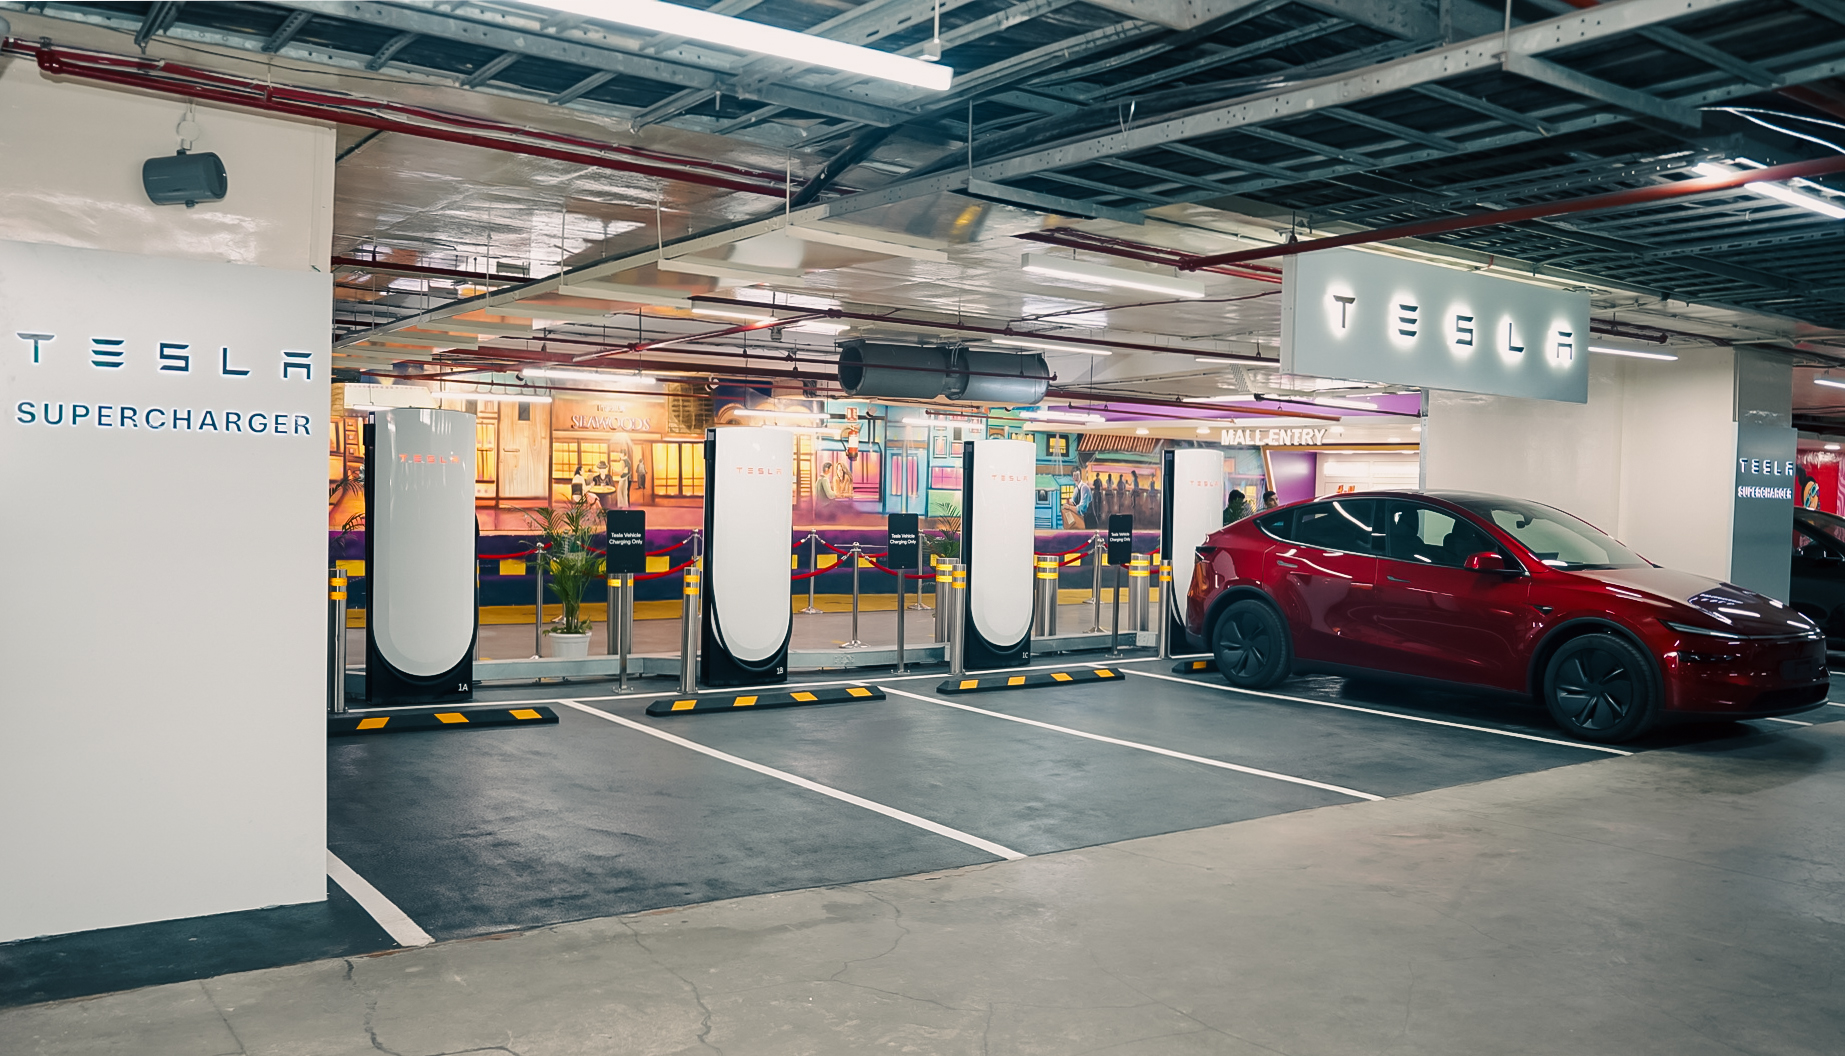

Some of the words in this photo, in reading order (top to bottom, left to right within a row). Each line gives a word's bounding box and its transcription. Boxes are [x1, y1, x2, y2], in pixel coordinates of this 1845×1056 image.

[1333, 294, 1574, 361] TESLA
[16, 332, 312, 380] TESLA
[16, 401, 311, 435] SUPERCHARGER
[571, 414, 651, 431] SEAWOODS
[1220, 429, 1268, 445] MALL
[1267, 429, 1327, 445] ENTRY
[399, 453, 459, 464] TESLA
[736, 466, 782, 475] TESLA
[991, 474, 1028, 482] TESLA
[1737, 485, 1793, 500] SUPERCHARGER
[458, 683, 468, 691] 1A
